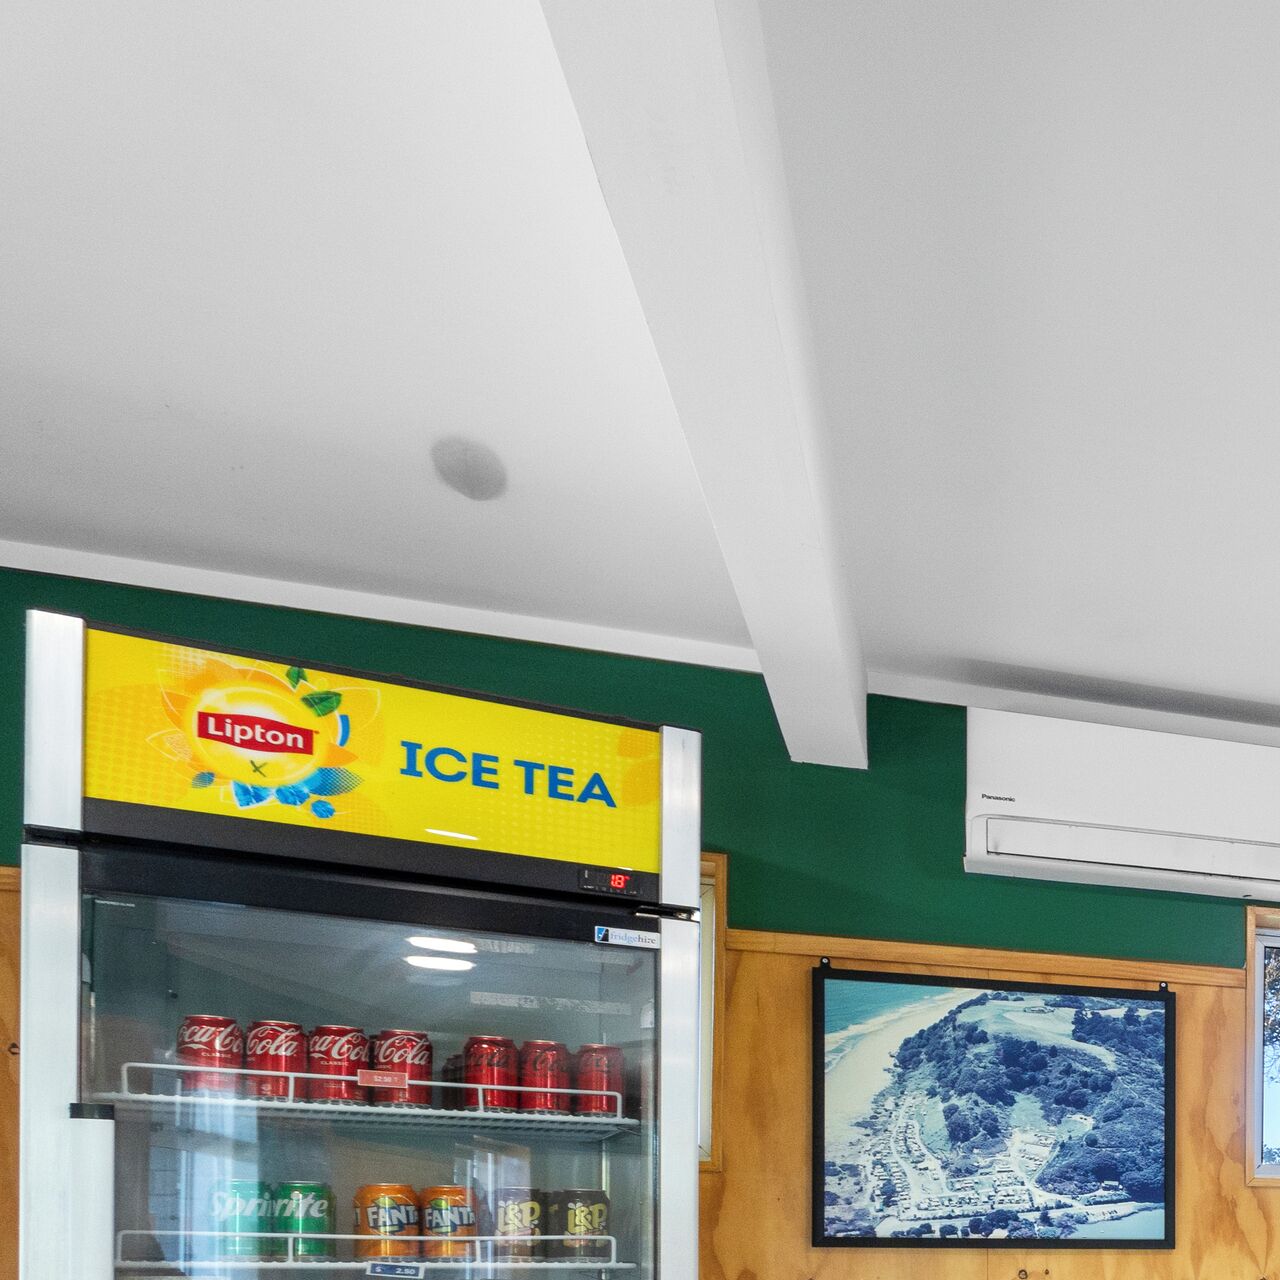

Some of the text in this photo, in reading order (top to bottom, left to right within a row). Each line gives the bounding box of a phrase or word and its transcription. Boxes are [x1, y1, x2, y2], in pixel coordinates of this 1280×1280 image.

[207, 716, 305, 750] Lipton
[400, 740, 617, 808] ICE TEA
[981, 793, 1016, 802] Panasonic
[610, 932, 657, 946] fridgehire
[498, 1200, 541, 1234] L&P
[567, 1202, 607, 1235] L&P
